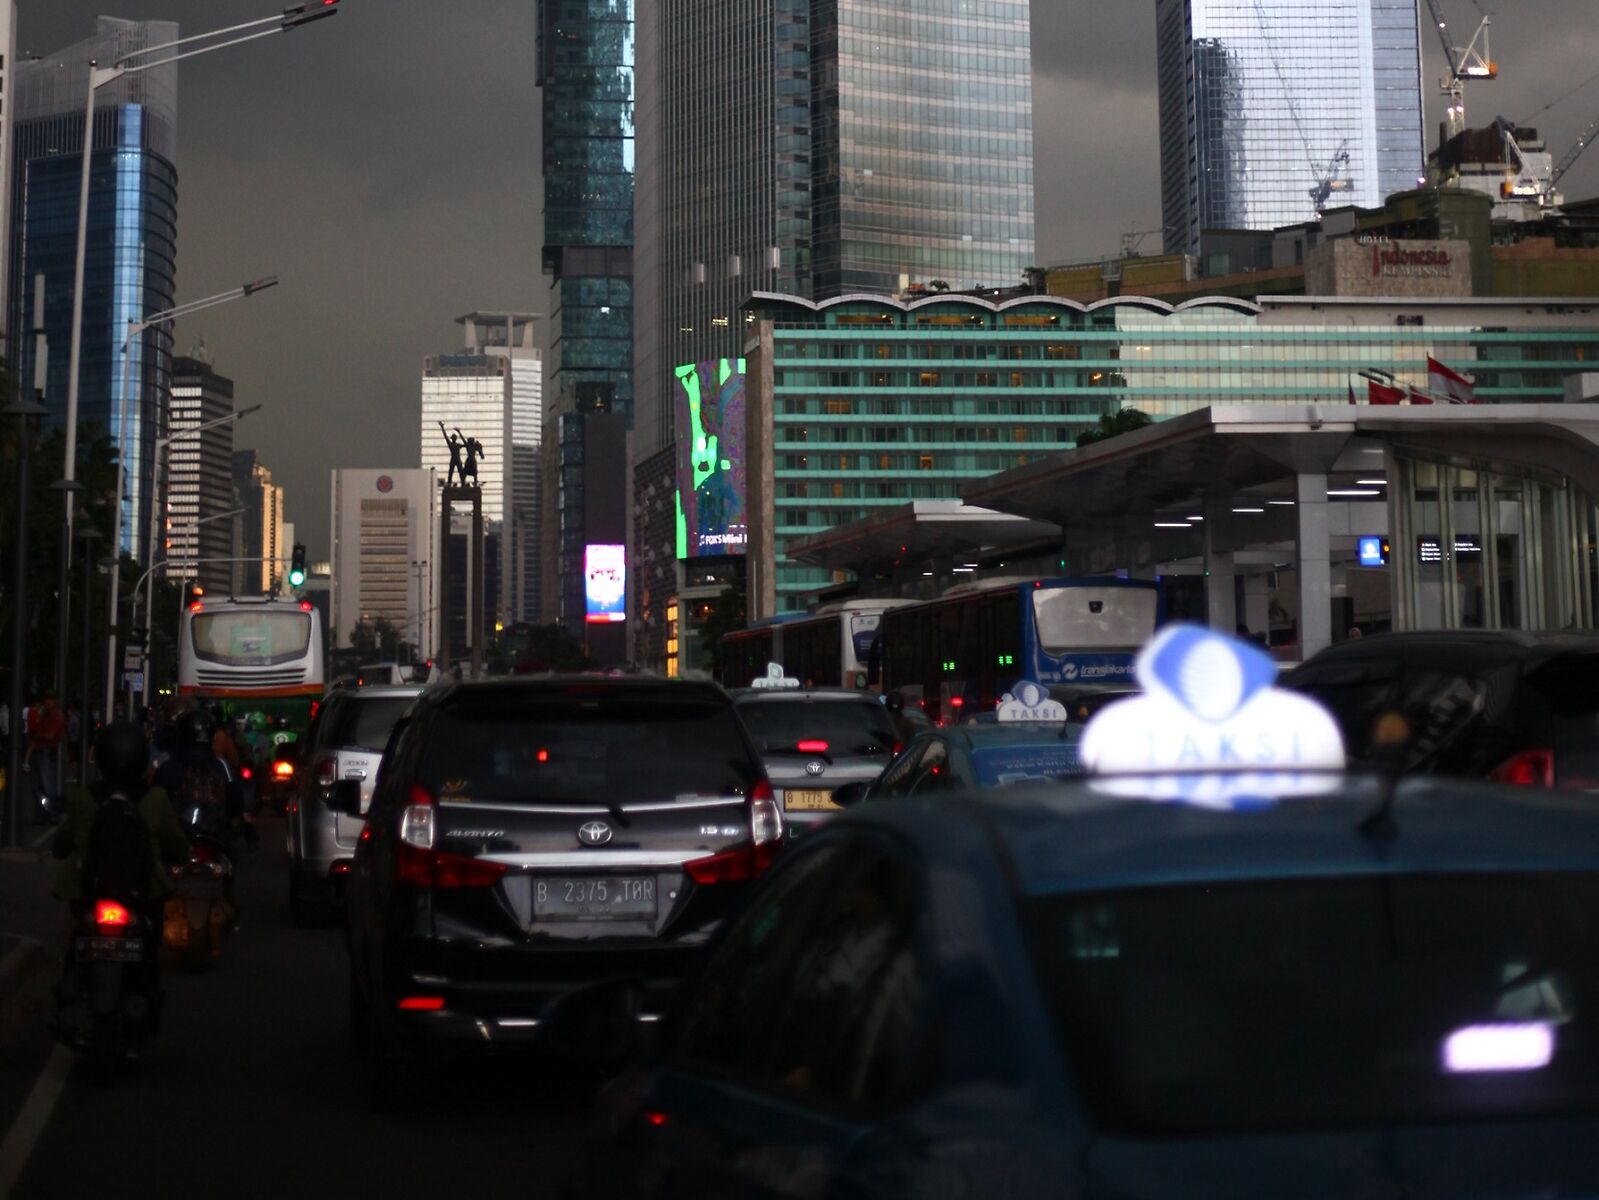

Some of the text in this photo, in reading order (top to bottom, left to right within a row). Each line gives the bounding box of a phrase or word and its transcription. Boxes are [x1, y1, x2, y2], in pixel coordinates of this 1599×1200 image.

[1372, 240, 1452, 276] Indonesia
[1010, 709, 1057, 720] TAKSI
[1145, 731, 1302, 764] TAKSI
[537, 881, 547, 902] B
[565, 881, 608, 902] 2375
